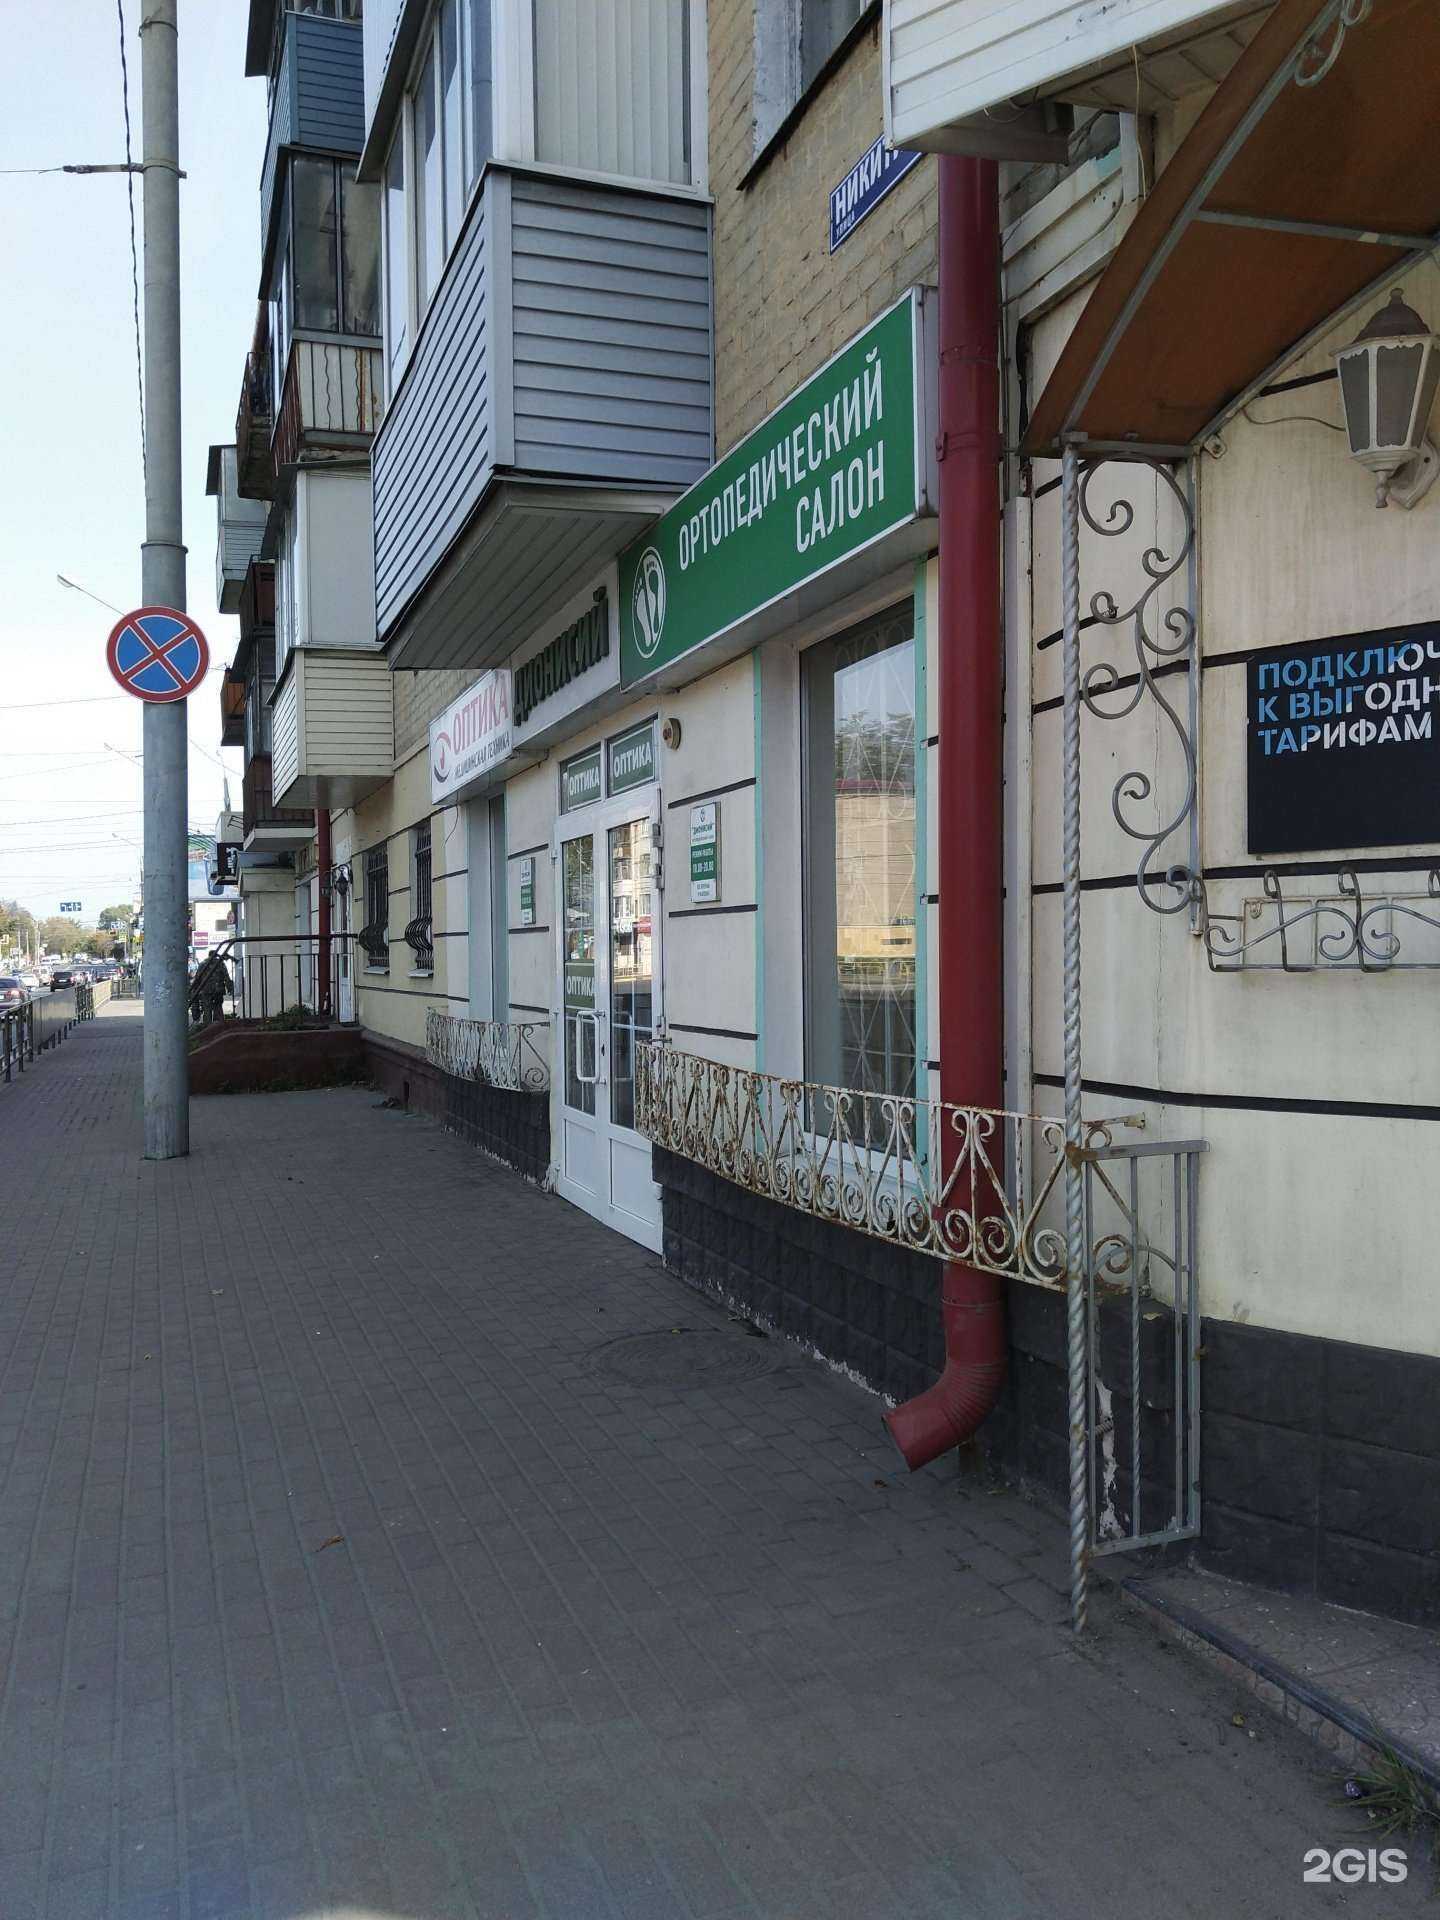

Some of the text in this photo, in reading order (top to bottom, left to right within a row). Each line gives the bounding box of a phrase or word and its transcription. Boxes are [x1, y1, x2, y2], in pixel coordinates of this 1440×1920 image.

[835, 139, 899, 225] НИКИ
[679, 347, 883, 571] ОРТОПЕДИЧЕСКИЙ
[796, 440, 885, 553] САЛОН
[513, 586, 610, 726] ДИОНИСИЙ
[453, 673, 509, 755] ОПТИКА
[1257, 711, 1432, 756] ТАРИФАМ
[1258, 695, 1279, 723] К
[569, 766, 600, 796] ОПТИКА
[613, 742, 652, 778] ОПТИКА
